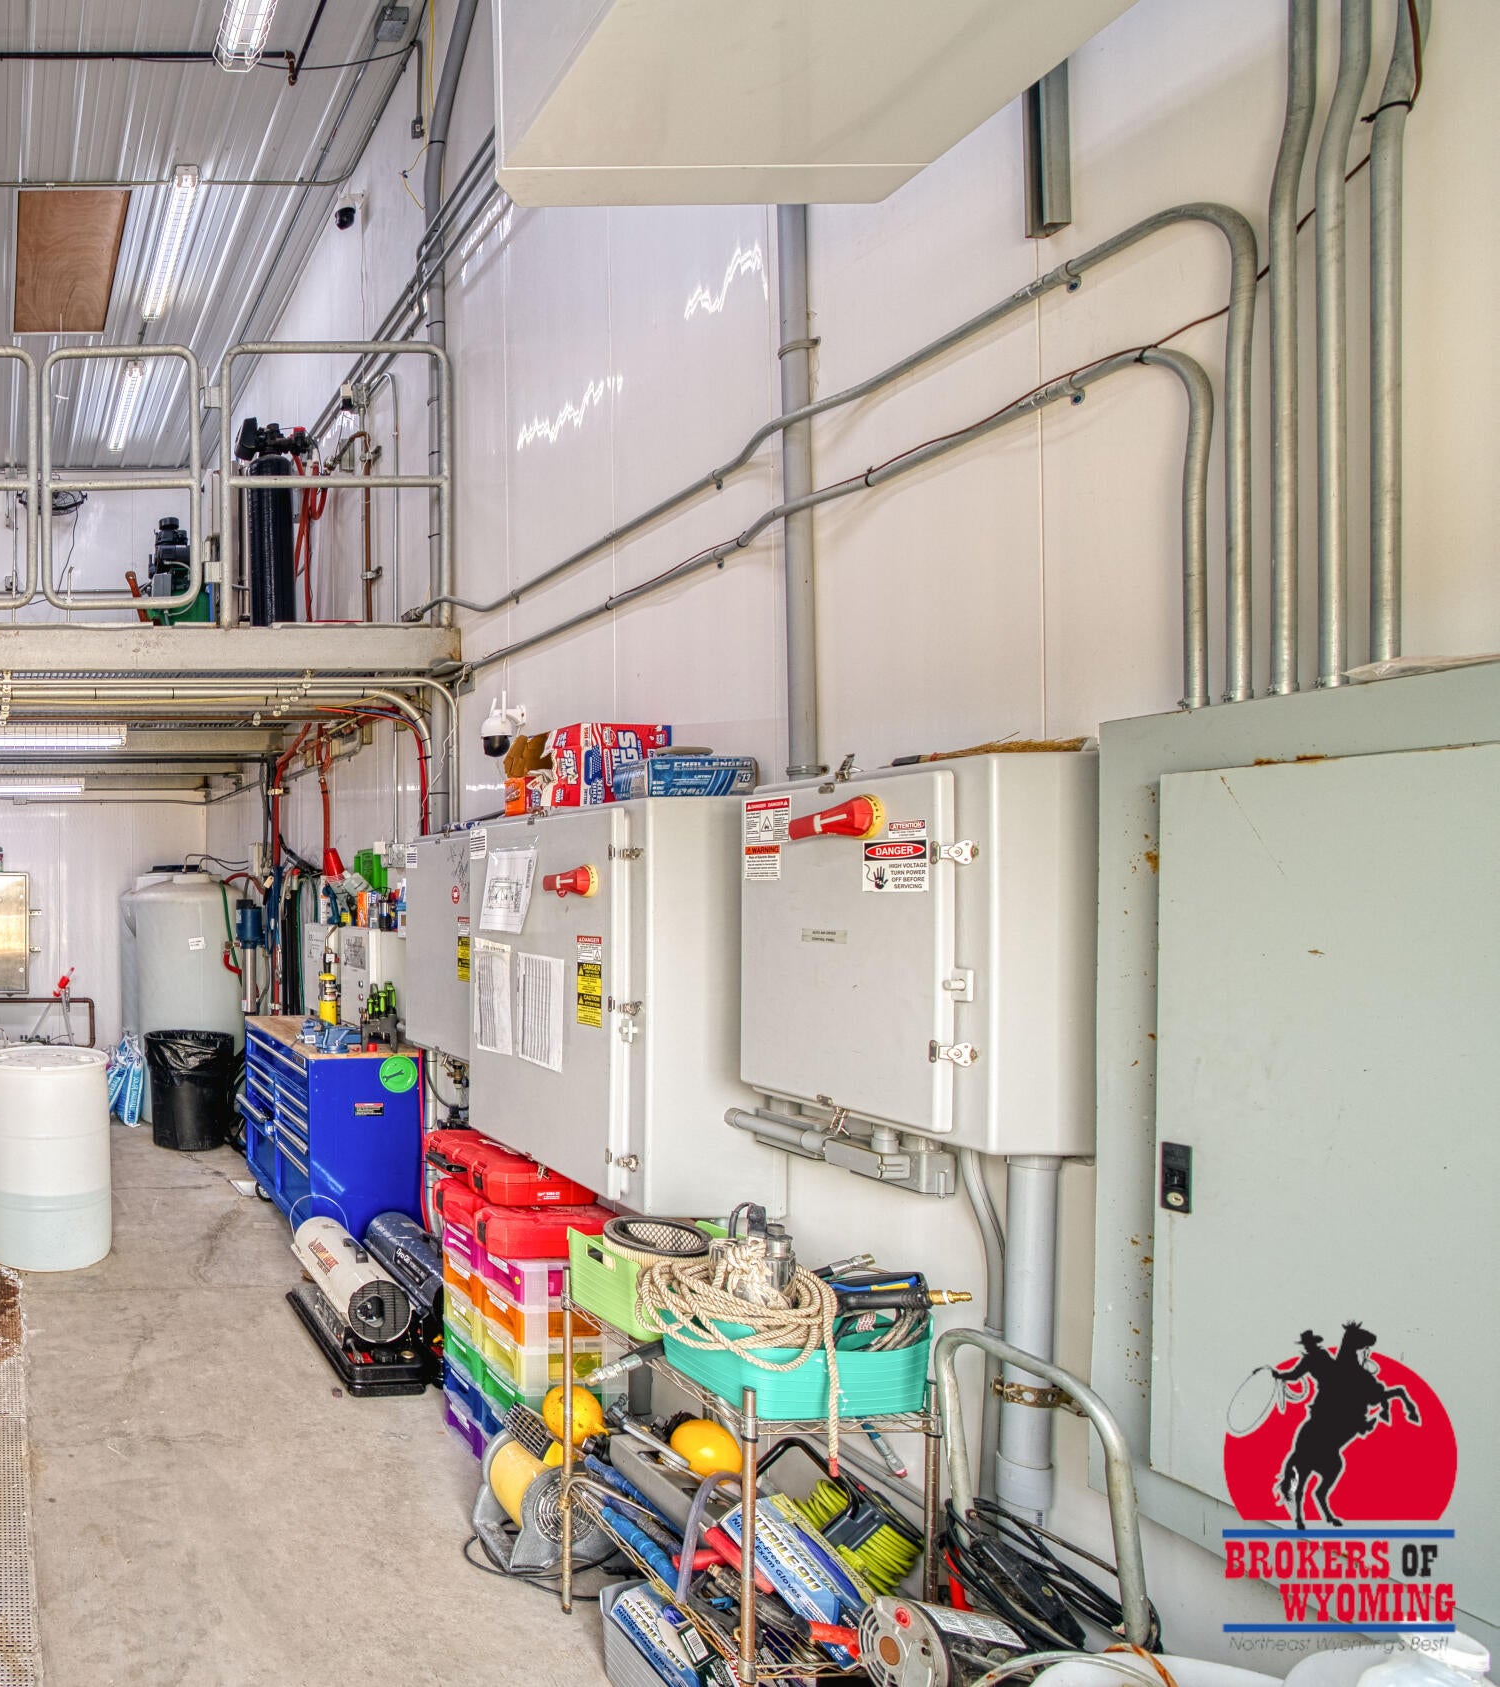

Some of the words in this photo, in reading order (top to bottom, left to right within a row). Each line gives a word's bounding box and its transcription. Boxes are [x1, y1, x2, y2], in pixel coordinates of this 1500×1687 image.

[617, 731, 640, 763] GS
[563, 750, 578, 784] RAGS
[892, 822, 922, 830] ATTENTION
[752, 846, 779, 854] WARNING
[875, 846, 914, 856] DANGER
[755, 1544, 777, 1571] Exam
[776, 1568, 802, 1599] Gloves
[795, 1567, 823, 1593] 911
[618, 1603, 656, 1649] Powder-Free
[623, 1598, 668, 1649] NITRILE
[666, 1648, 686, 1671] 911
[616, 1608, 637, 1631] Nitrile
[636, 1630, 653, 1652] Exam
[652, 1650, 676, 1678] Gloves
